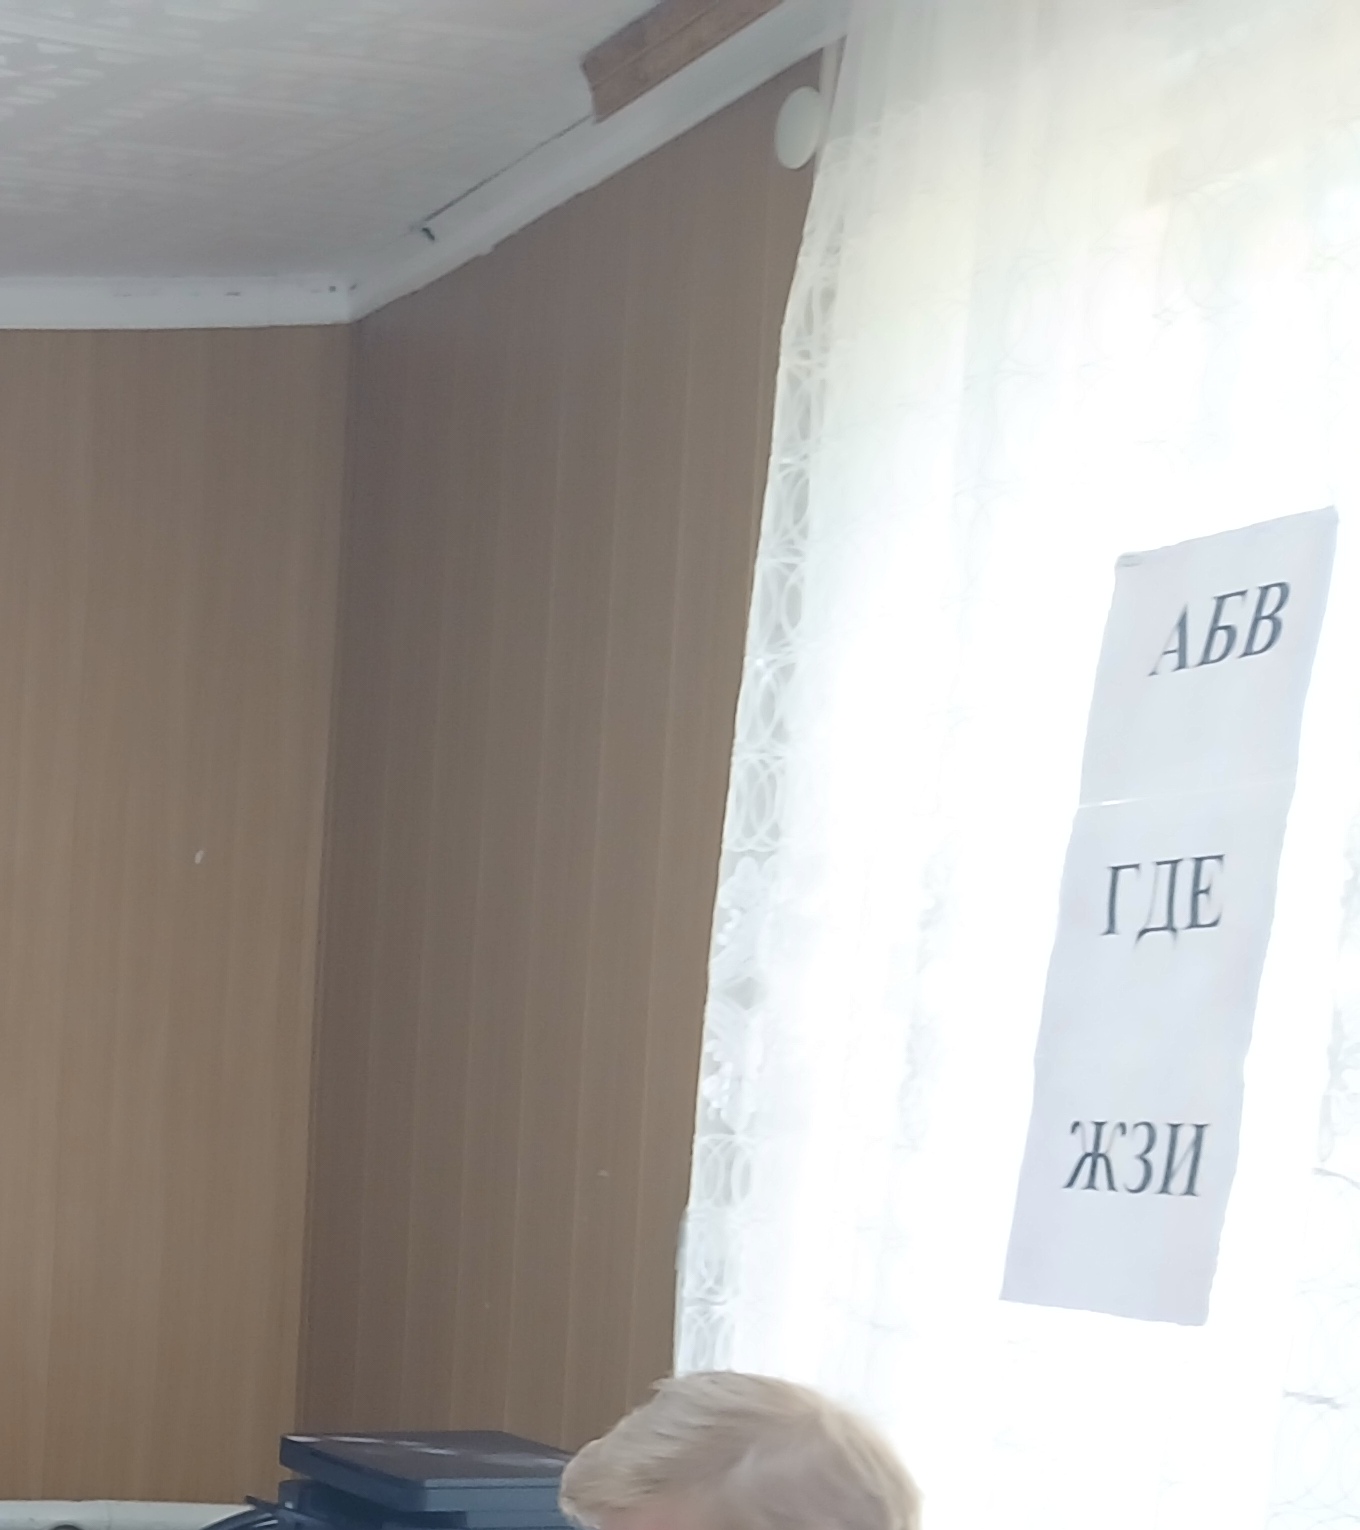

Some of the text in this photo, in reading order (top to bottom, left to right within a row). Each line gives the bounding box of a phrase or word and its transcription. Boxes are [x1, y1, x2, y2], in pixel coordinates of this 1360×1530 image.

[1147, 581, 1291, 677] АБВ
[1100, 853, 1226, 948] ГДЕ
[1062, 1119, 1211, 1197] ЖЗИ
